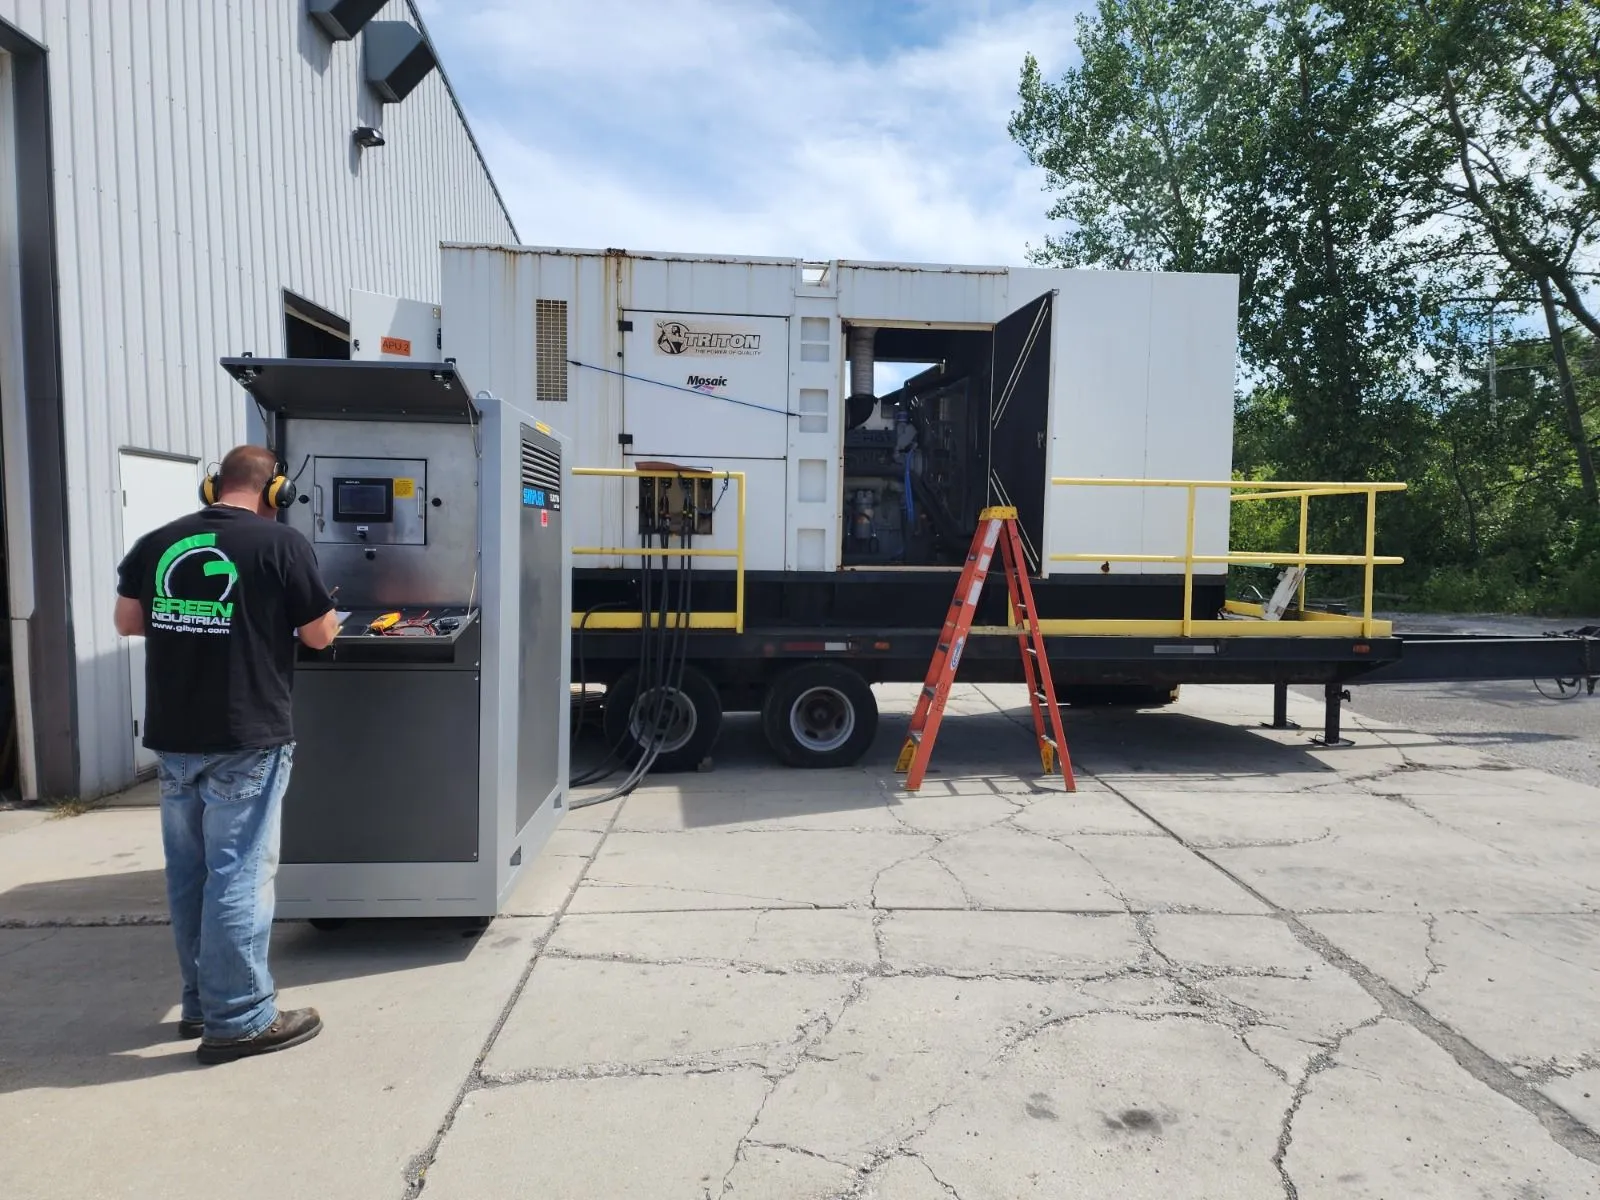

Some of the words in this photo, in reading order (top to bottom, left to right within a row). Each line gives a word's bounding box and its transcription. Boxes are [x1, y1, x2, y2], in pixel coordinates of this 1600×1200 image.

[382, 340, 402, 351] APU
[684, 332, 760, 349] TRITON
[687, 376, 727, 386] Mosaic
[152, 597, 233, 617] GREEN
[152, 611, 230, 626] NDUSTRIAL
